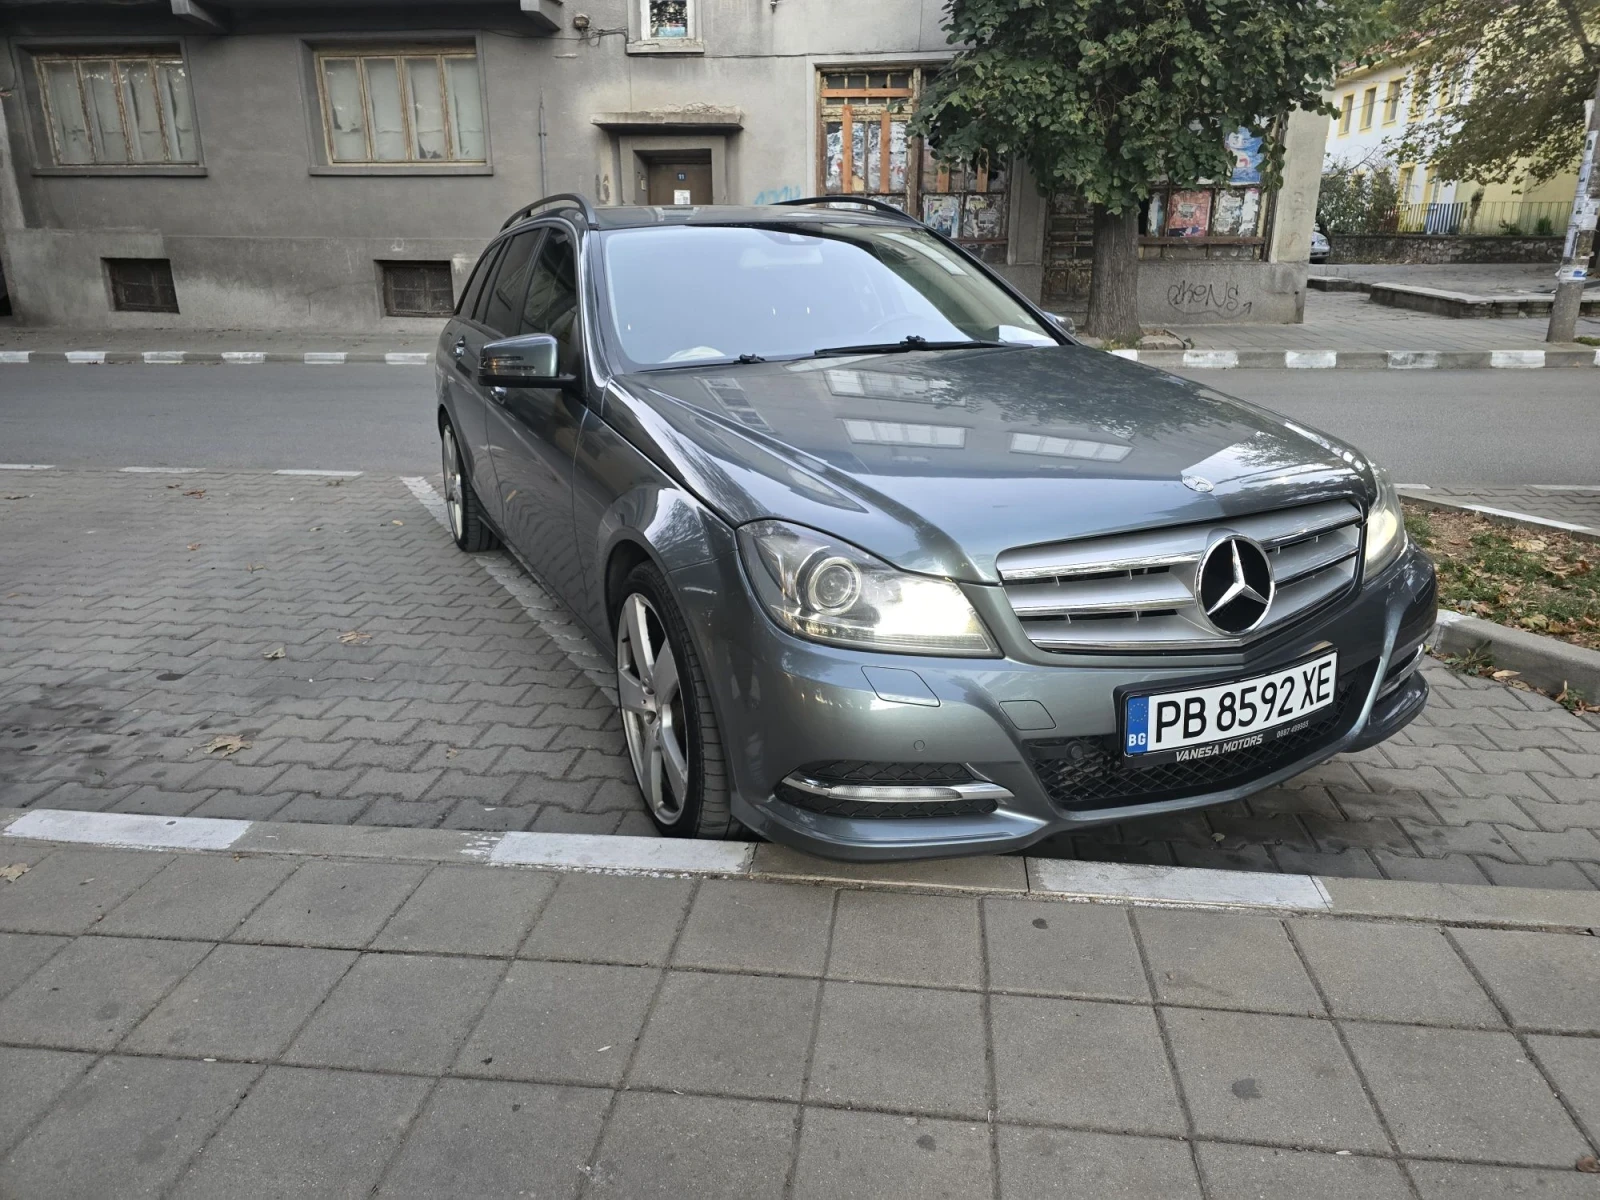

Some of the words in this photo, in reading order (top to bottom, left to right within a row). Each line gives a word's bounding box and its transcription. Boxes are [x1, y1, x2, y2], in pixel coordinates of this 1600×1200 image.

[1155, 696, 1207, 744] PB
[1216, 675, 1296, 732] 8592
[1300, 660, 1332, 710] XE
[1128, 733, 1147, 747] BG
[1175, 743, 1220, 762] VANESA
[1222, 734, 1264, 754] MOTORS
